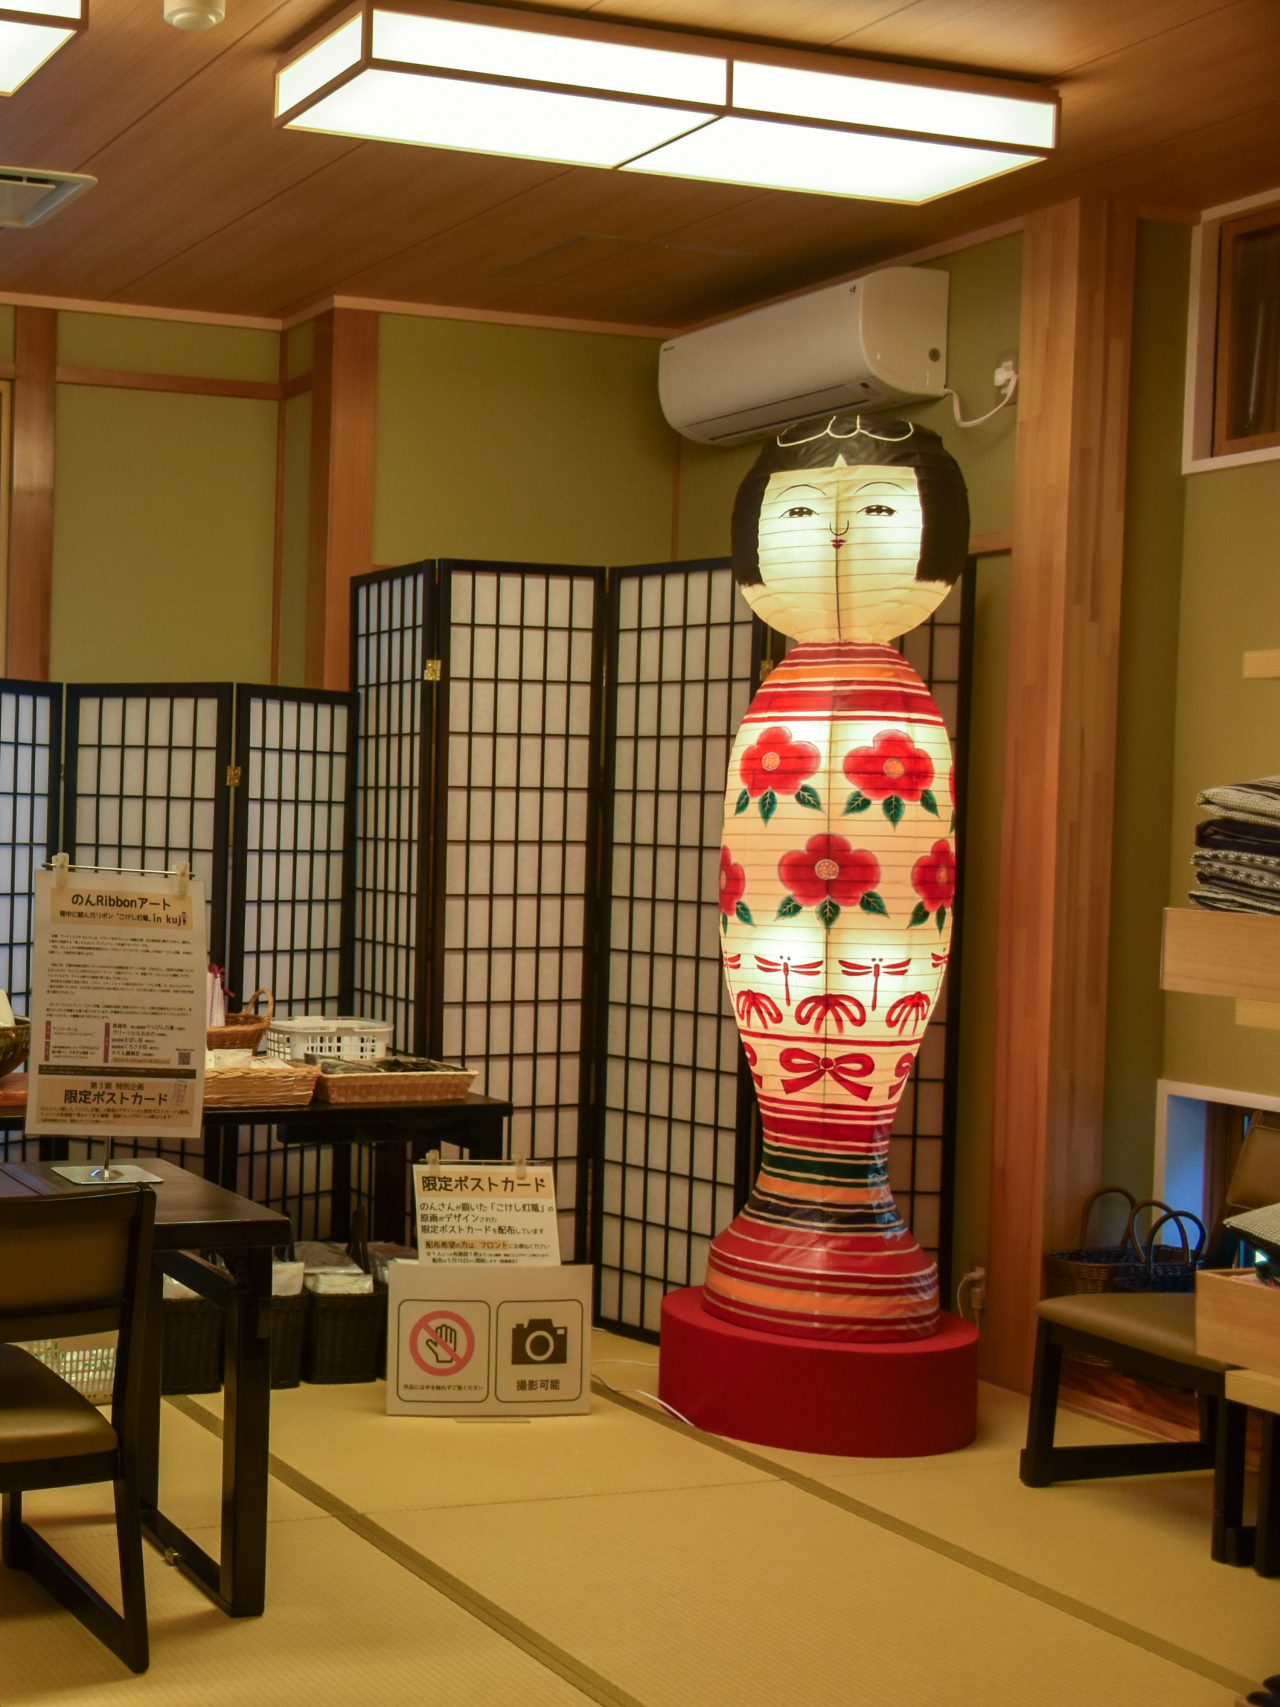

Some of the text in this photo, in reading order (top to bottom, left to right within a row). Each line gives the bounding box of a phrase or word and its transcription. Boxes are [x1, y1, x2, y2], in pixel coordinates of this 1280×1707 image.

[71, 893, 171, 911] のんRibbonアート
[153, 913, 162, 923] in
[64, 1089, 168, 1106] 限定ポストカード
[421, 1175, 546, 1193] 限定ポストカード
[516, 1379, 561, 1391] 撮影可能
